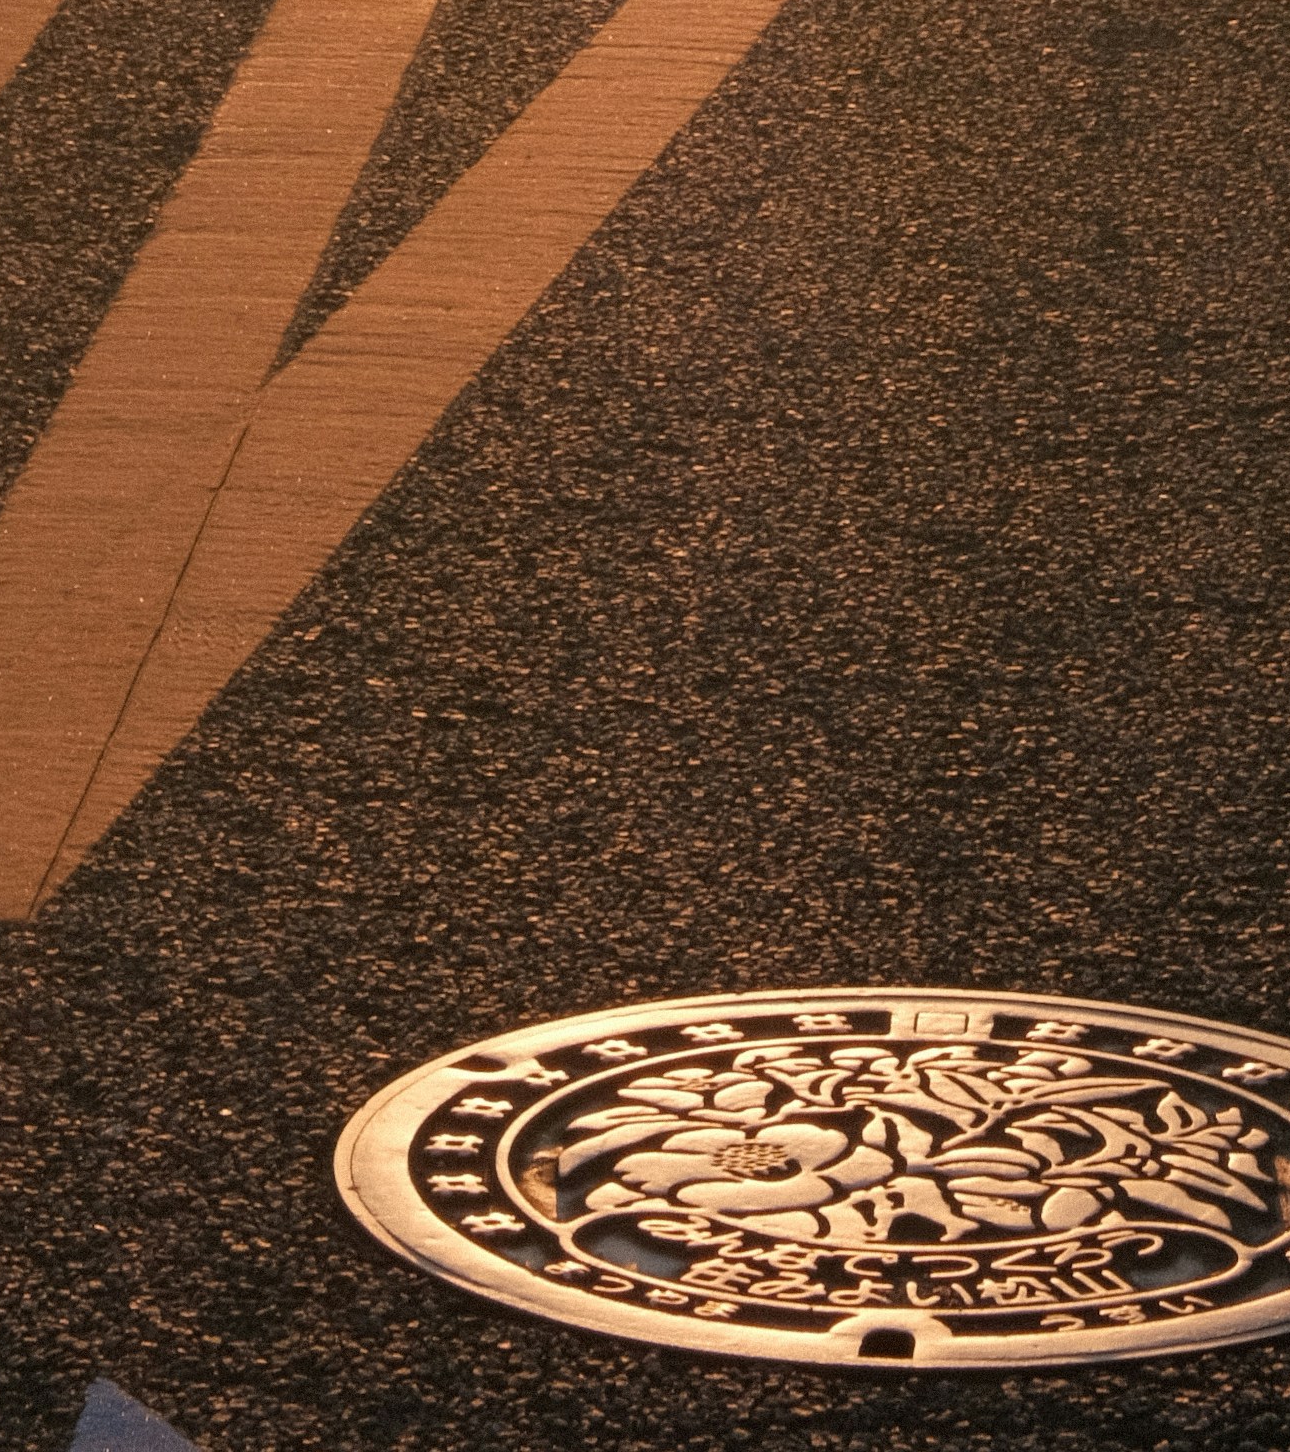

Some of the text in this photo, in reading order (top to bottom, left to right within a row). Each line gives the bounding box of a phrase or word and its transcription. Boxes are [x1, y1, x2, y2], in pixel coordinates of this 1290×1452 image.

[638, 1215, 1163, 1278] みんなでつくろう
[543, 1261, 740, 1318] まつやま
[680, 1259, 1135, 1307] 住みよい松山
[1039, 1290, 1213, 1331] うすい
